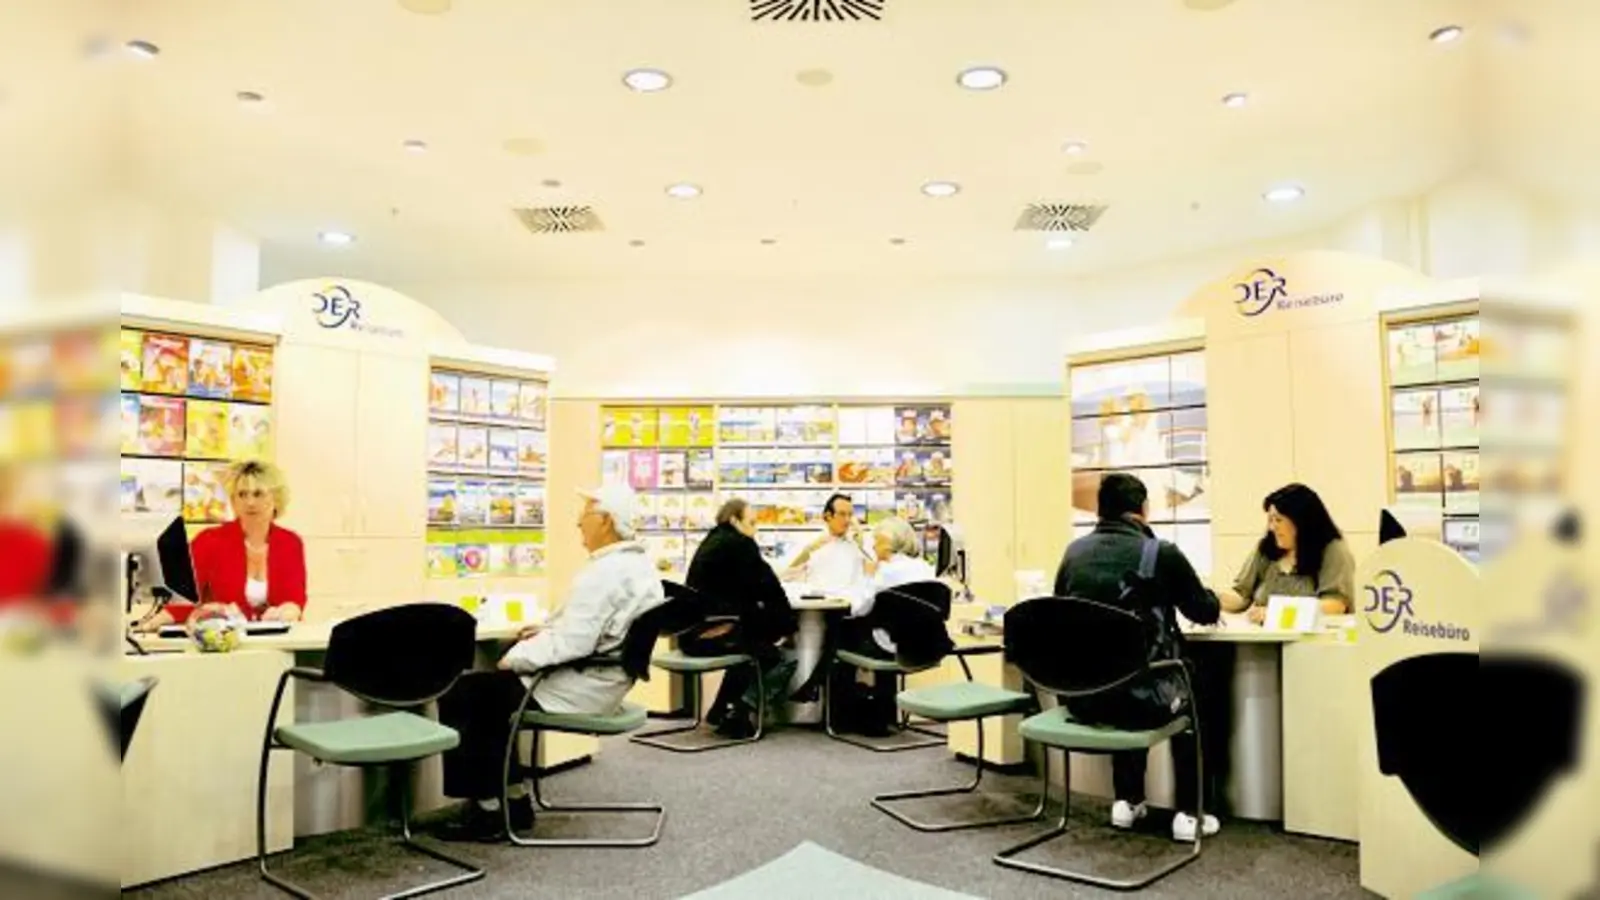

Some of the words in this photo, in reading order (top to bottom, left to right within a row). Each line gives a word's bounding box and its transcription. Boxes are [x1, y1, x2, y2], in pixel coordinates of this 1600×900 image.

[310, 292, 361, 328] DER
[1233, 276, 1288, 316] DER
[1363, 584, 1414, 633] DER
[1403, 618, 1470, 642] Reisebüro
